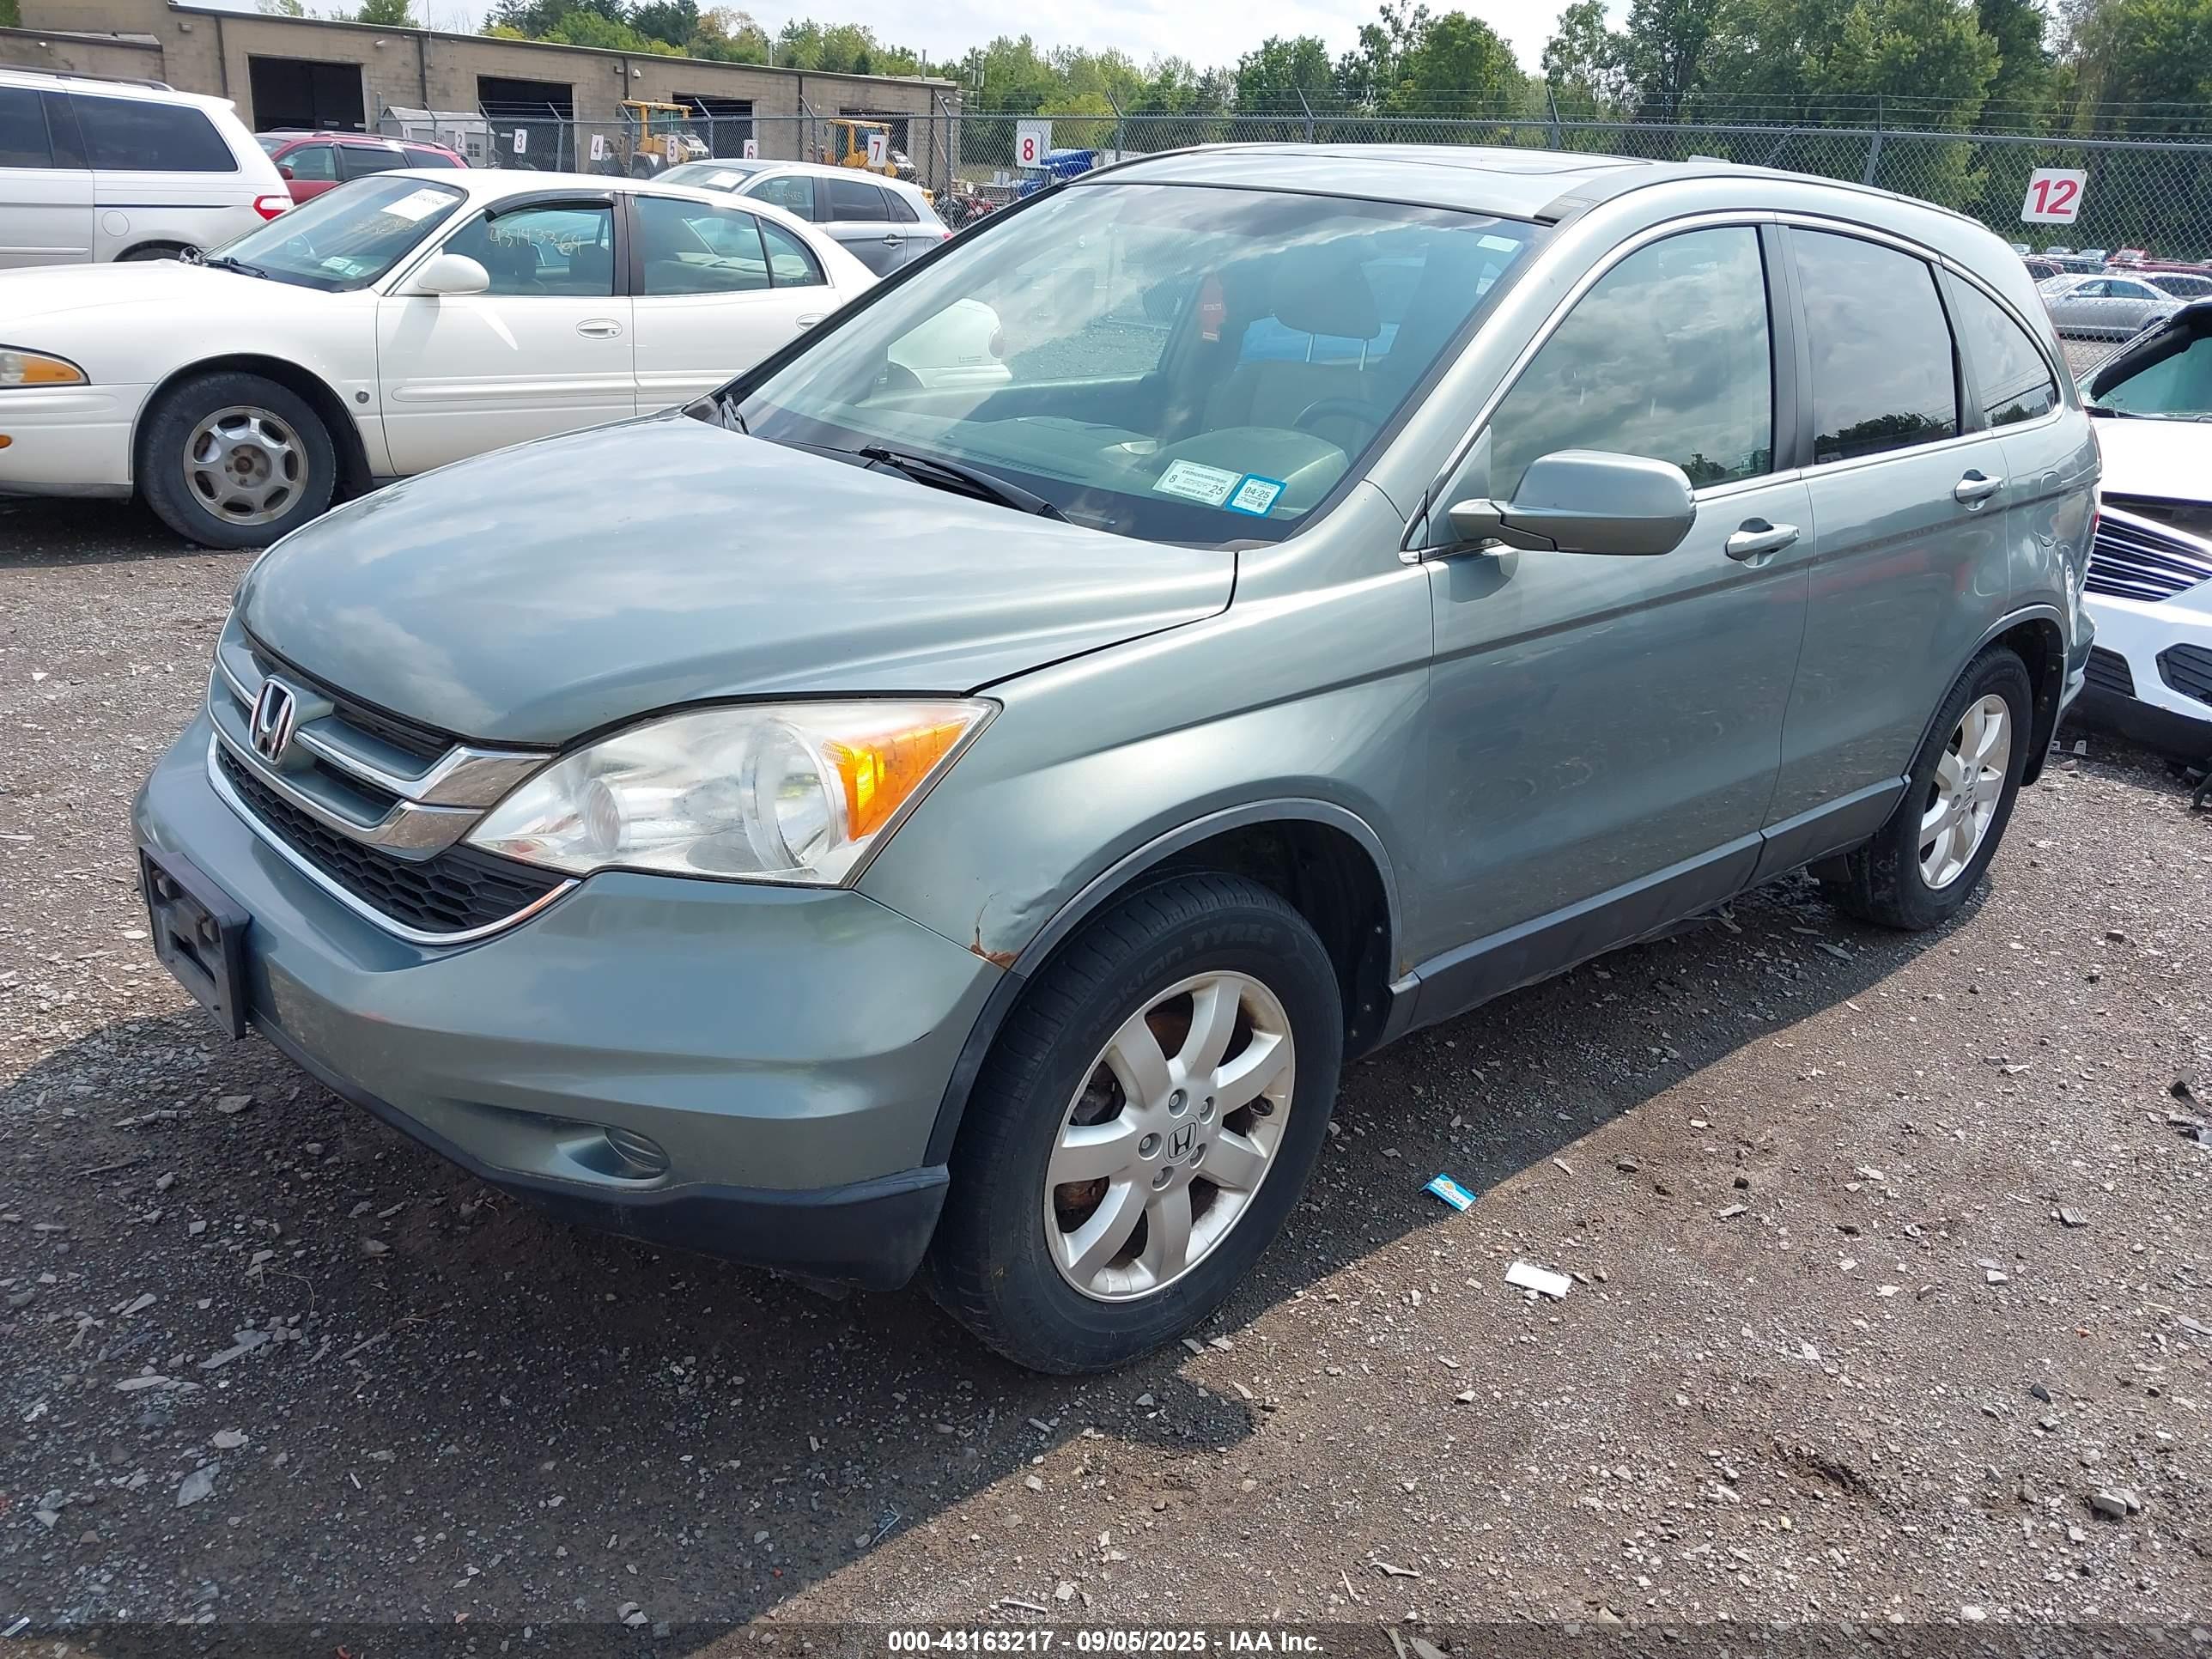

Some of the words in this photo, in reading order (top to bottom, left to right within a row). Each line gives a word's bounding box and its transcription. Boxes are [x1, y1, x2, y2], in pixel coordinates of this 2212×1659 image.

[458, 133, 463, 149] 2
[517, 135, 524, 149] 3
[593, 140, 599, 155] 4
[670, 141, 675, 157] 5
[1023, 137, 1035, 161] 8
[745, 145, 753, 159] 6
[873, 141, 881, 161] 7
[2033, 179, 2078, 215] 12
[1169, 474, 1178, 483] 8
[1209, 484, 1226, 495] 25
